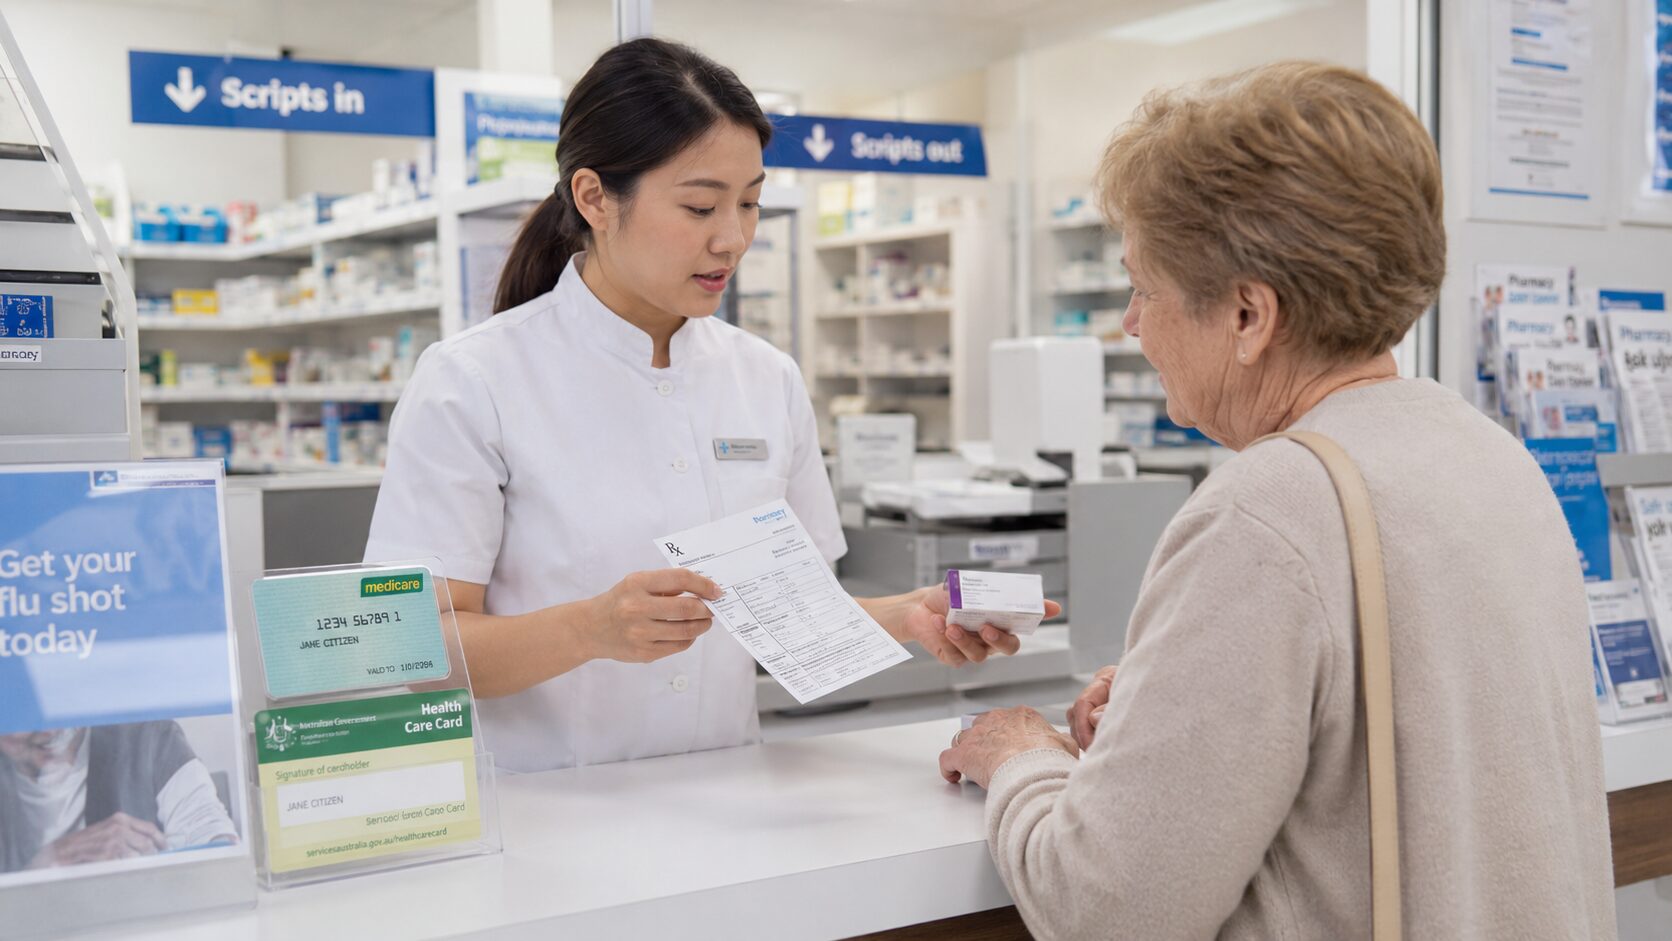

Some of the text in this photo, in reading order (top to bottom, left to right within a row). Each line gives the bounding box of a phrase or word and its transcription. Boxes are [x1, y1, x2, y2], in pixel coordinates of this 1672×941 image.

[221, 76, 365, 117] Scripts in
[851, 132, 964, 166] Scripts out
[665, 542, 684, 556] Rx
[0, 549, 137, 582] Get your
[365, 579, 420, 593] medicare
[0, 583, 126, 617] flu shot
[317, 611, 402, 630] 1234 56789 1
[0, 623, 97, 659] today
[323, 635, 360, 648] CITIZEN
[421, 700, 462, 715] Health
[404, 715, 463, 733] Care Card
[275, 766, 315, 782] Signature
[316, 765, 325, 775] of
[287, 794, 344, 811] JANE CITIZEN
